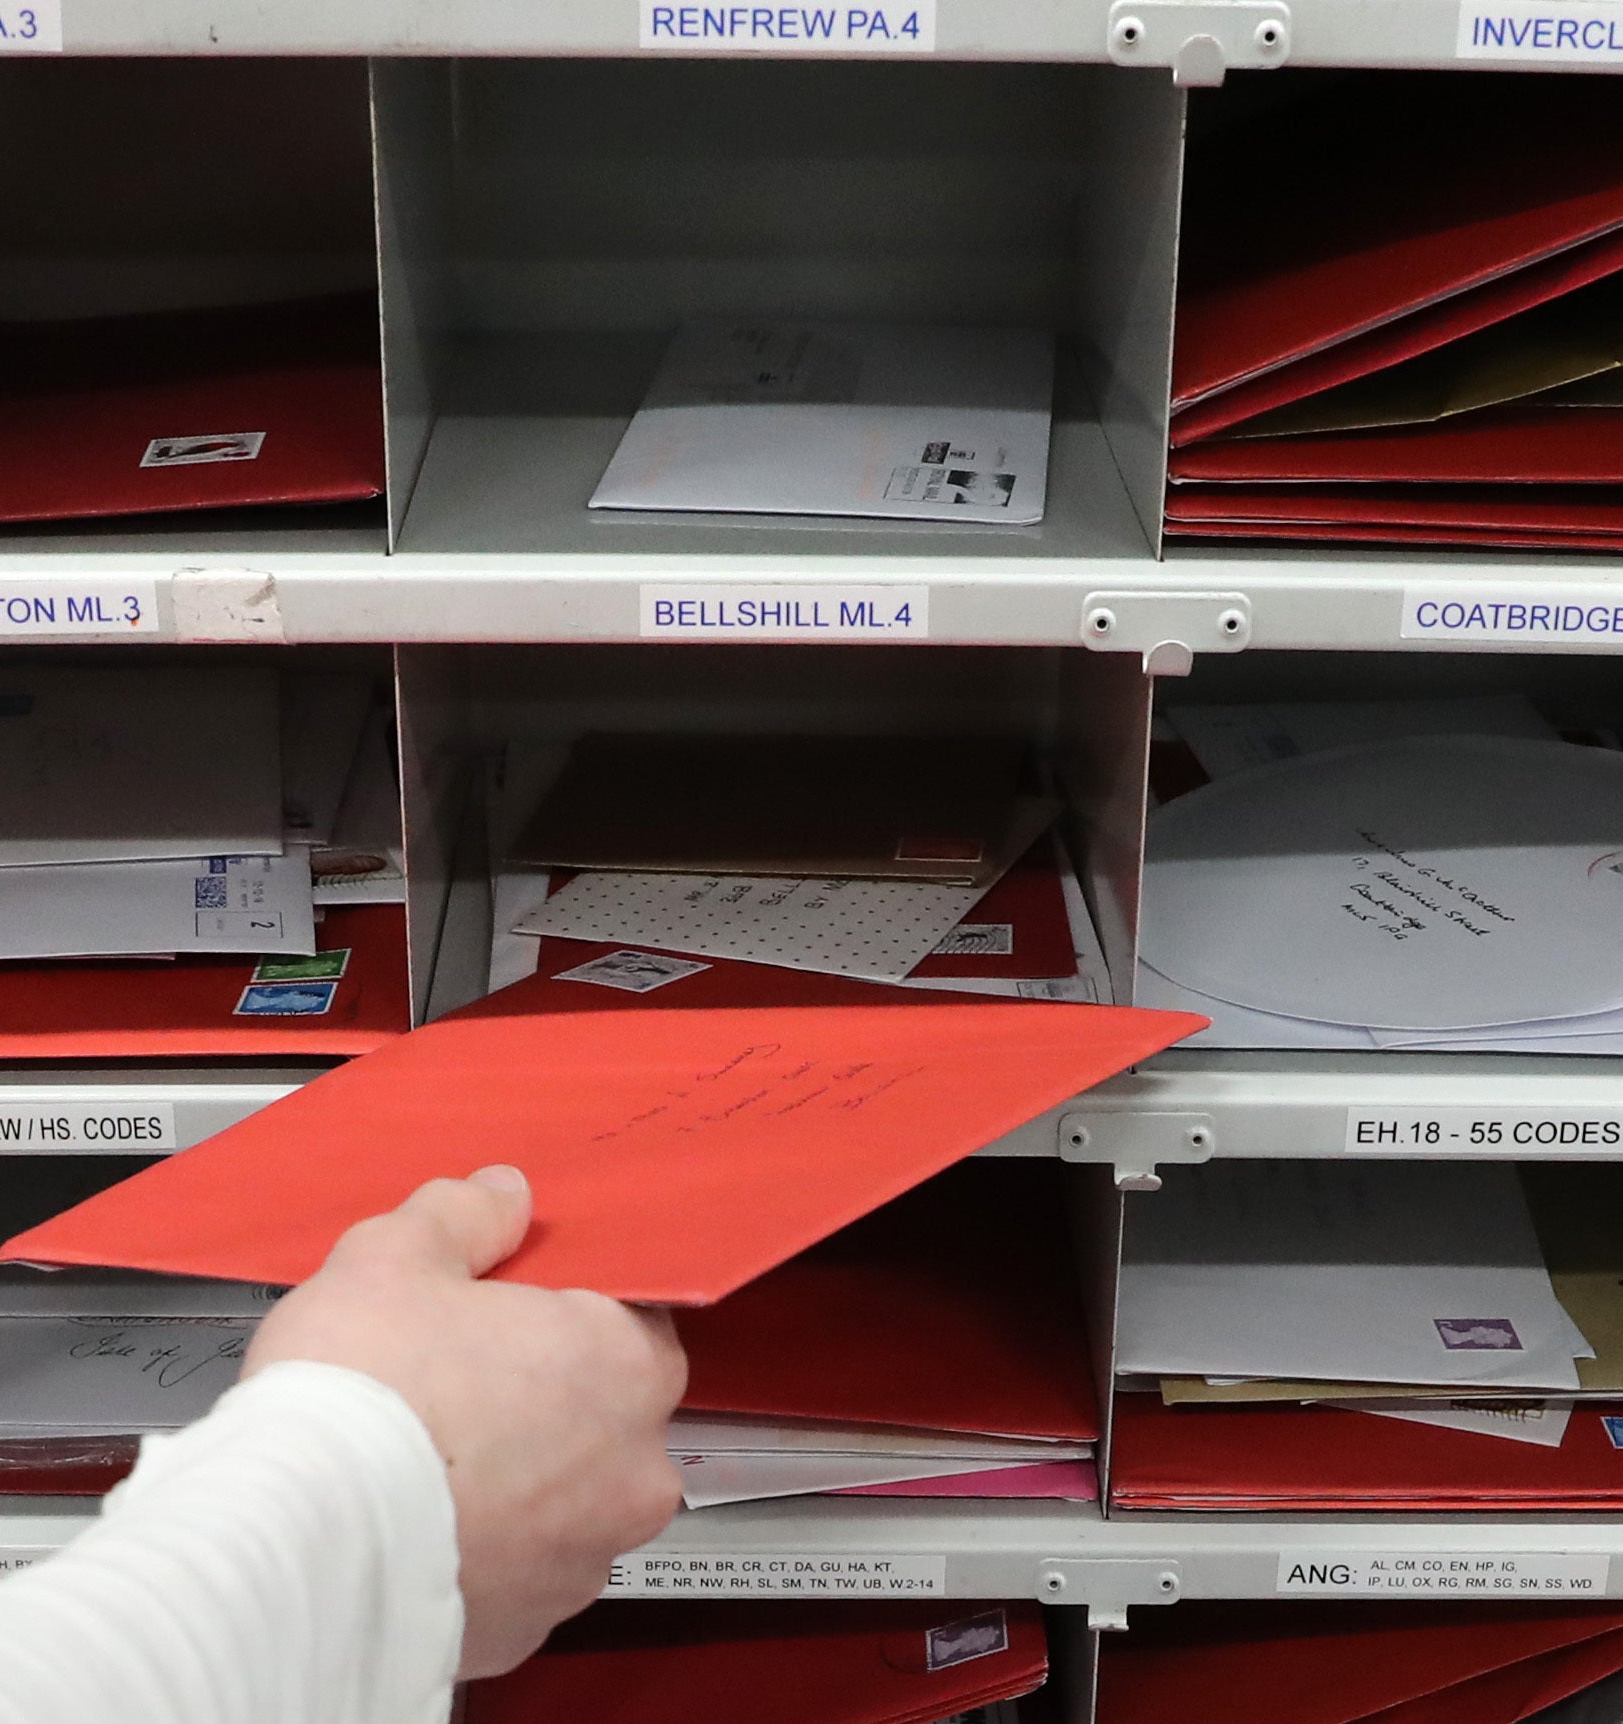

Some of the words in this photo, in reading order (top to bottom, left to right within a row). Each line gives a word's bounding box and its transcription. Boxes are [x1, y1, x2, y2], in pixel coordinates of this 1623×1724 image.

[653, 7, 836, 38] RENFREW
[847, 9, 920, 40] PA.4
[67, 596, 141, 625] ML.3
[655, 600, 830, 627] BELLSHILL
[840, 601, 912, 627] ML.4
[40, 1117, 76, 1140] HS.
[83, 1116, 162, 1140] CODES
[1357, 1121, 1440, 1144] EH.18
[1469, 1121, 1503, 1144] 55
[1513, 1121, 1621, 1144] CODES
[1287, 1564, 1357, 1585] ANG:
